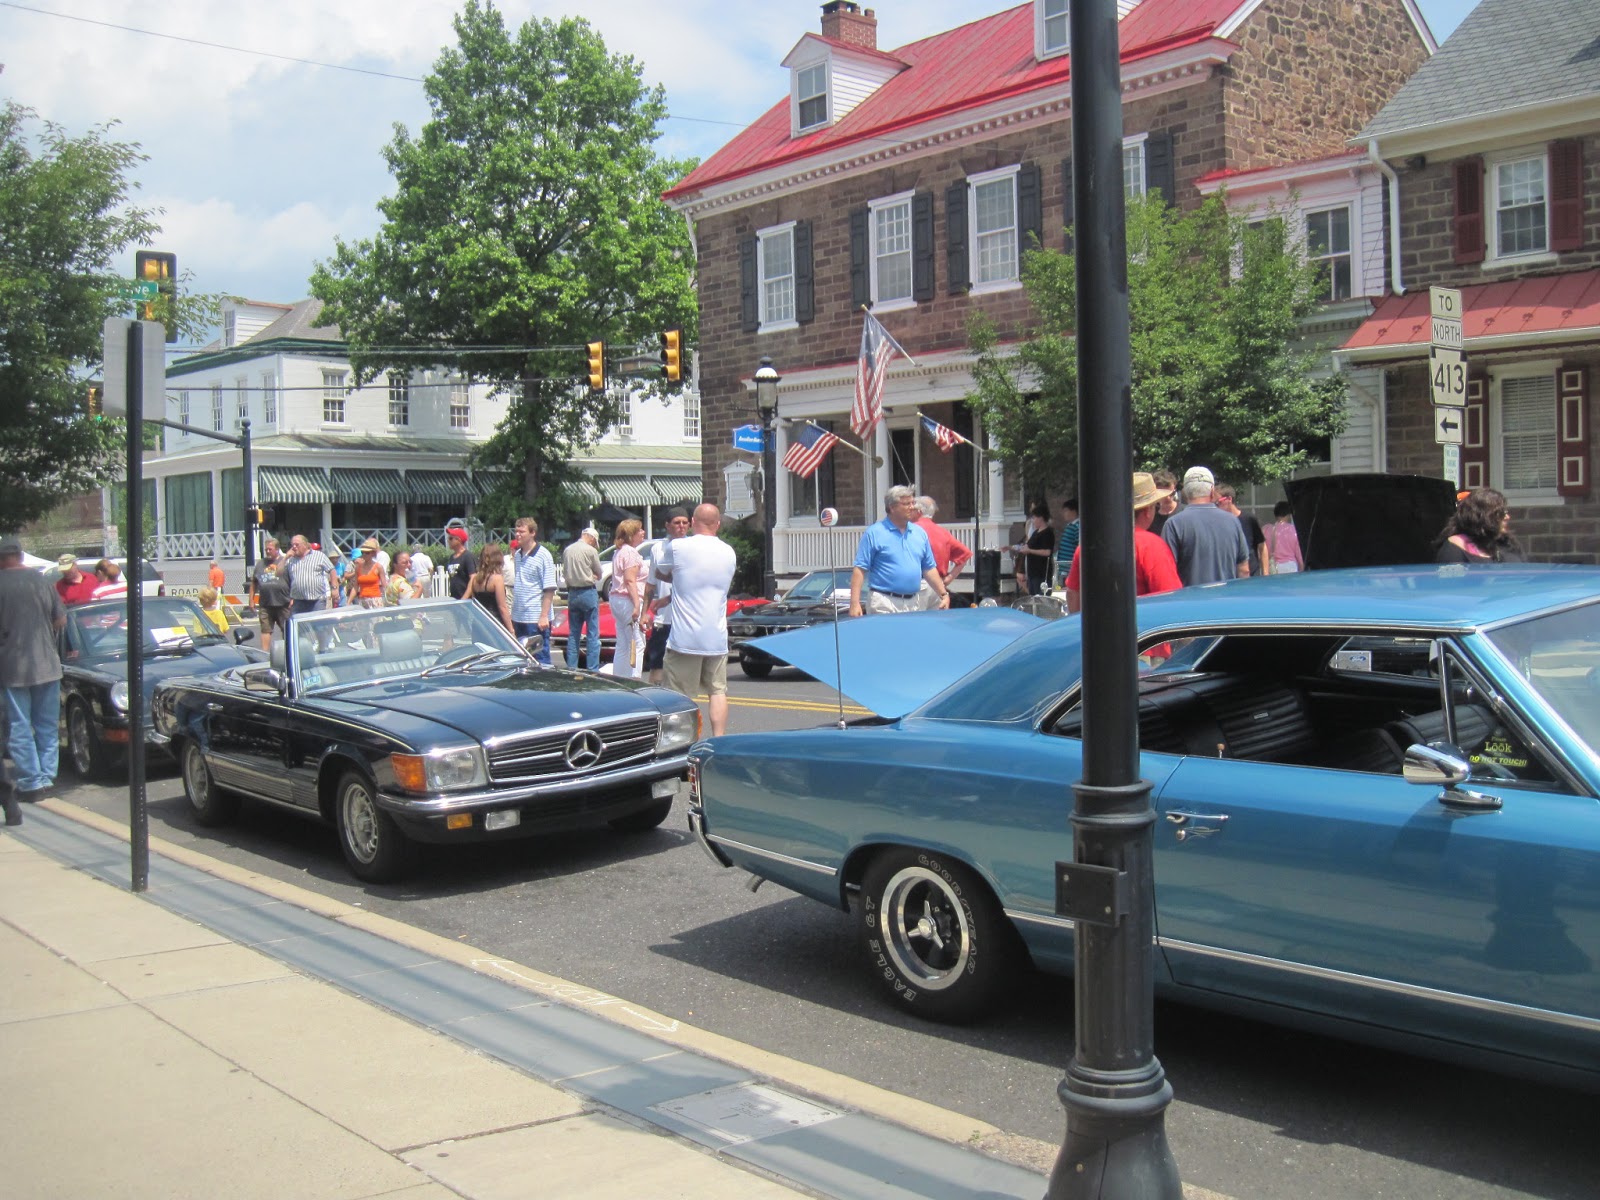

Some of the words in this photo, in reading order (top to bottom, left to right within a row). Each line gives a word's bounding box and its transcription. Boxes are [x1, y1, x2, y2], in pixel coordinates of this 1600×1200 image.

[1438, 294, 1453, 311] TO
[1433, 322, 1461, 342] NORTH
[1434, 363, 1465, 394] 413
[171, 588, 199, 597] ROAD
[1469, 755, 1480, 763] DO
[1481, 756, 1497, 764] NOT
[1499, 757, 1528, 767] TOUCH!
[865, 896, 875, 928] GT
[869, 939, 917, 1001] EAGLE
